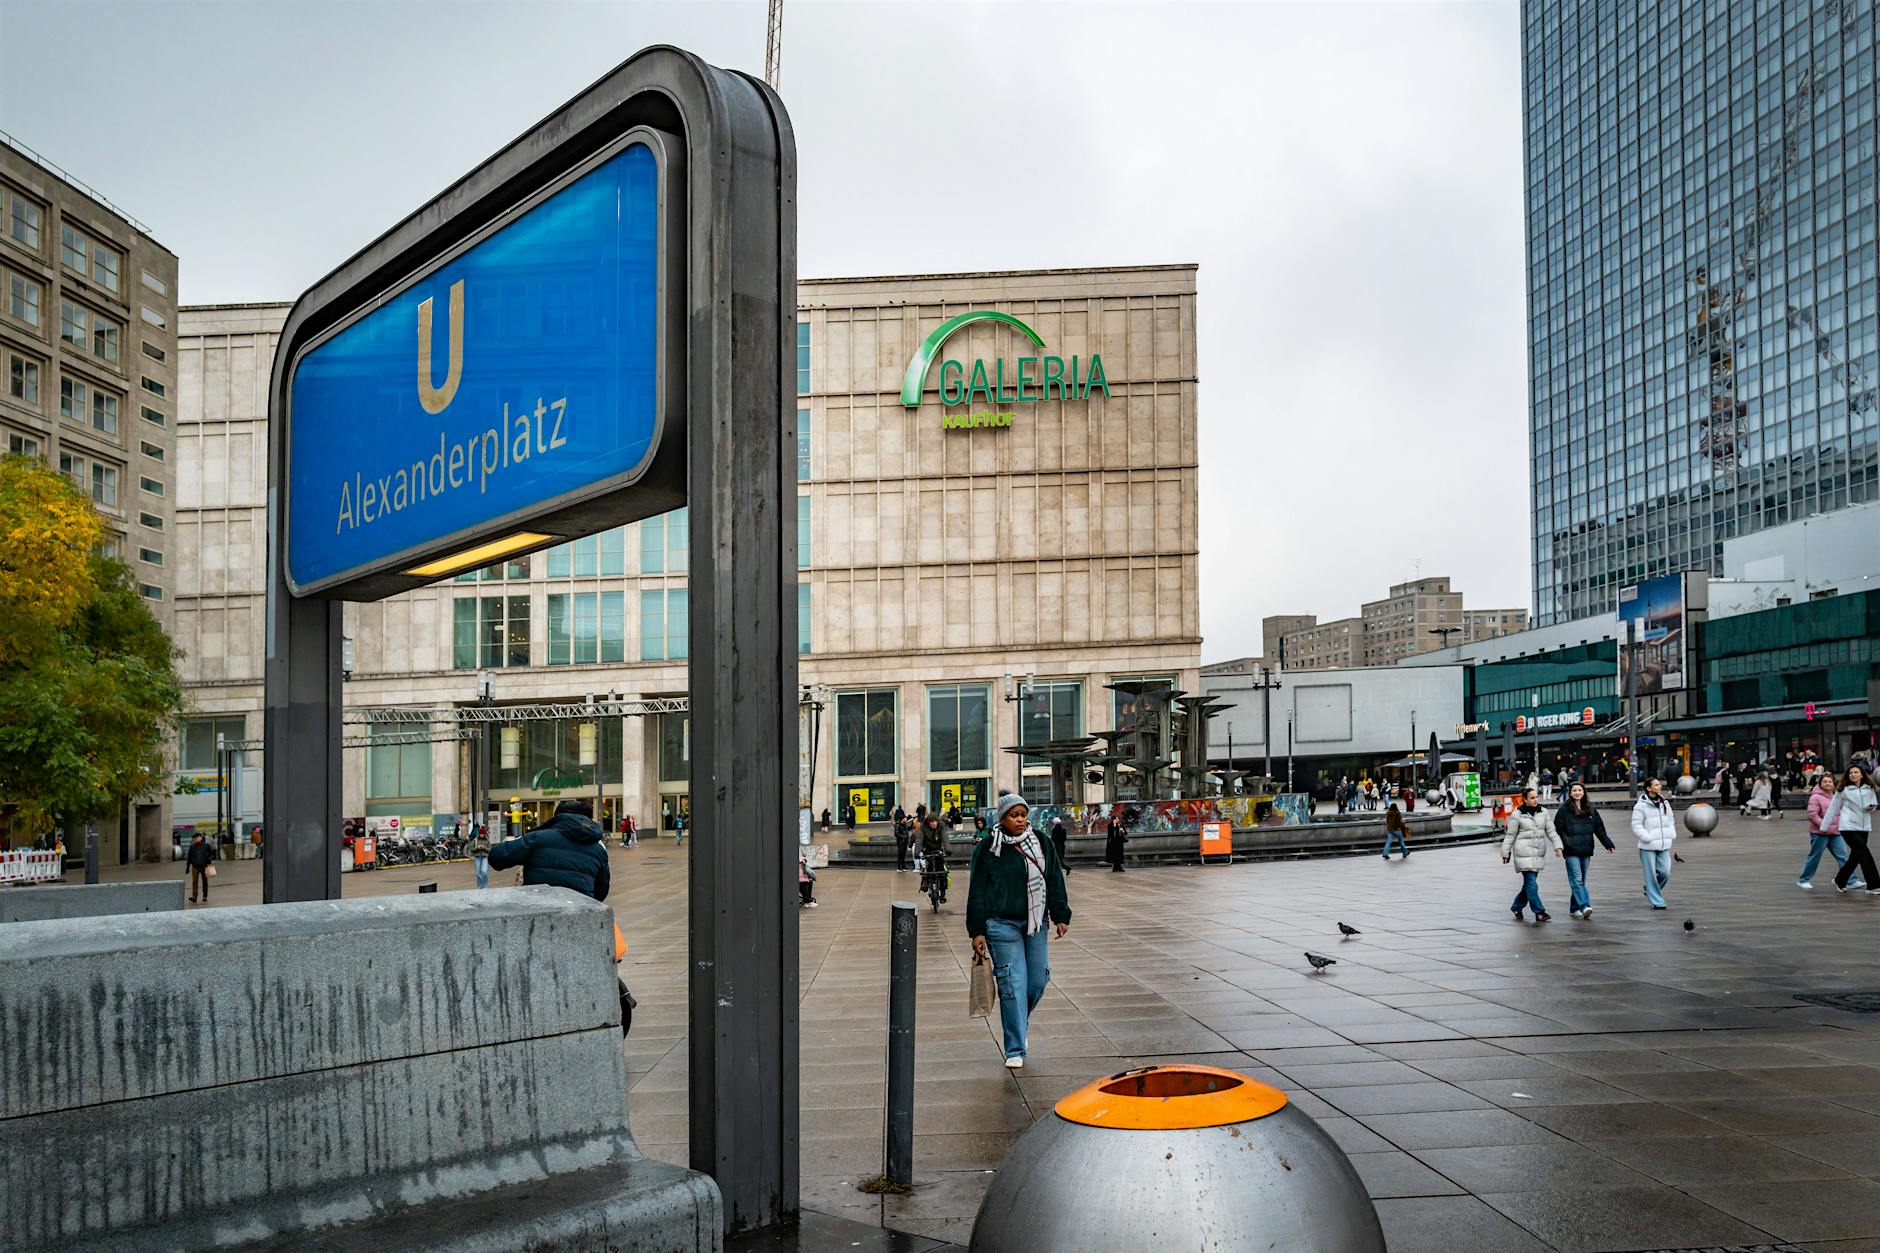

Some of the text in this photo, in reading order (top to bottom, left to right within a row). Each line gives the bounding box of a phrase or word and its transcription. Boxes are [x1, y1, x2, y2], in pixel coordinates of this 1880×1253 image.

[417, 278, 465, 415] U
[939, 353, 1111, 406] GALERIA
[336, 397, 567, 535] Alexanderplatz
[1559, 711, 1581, 726] KING
